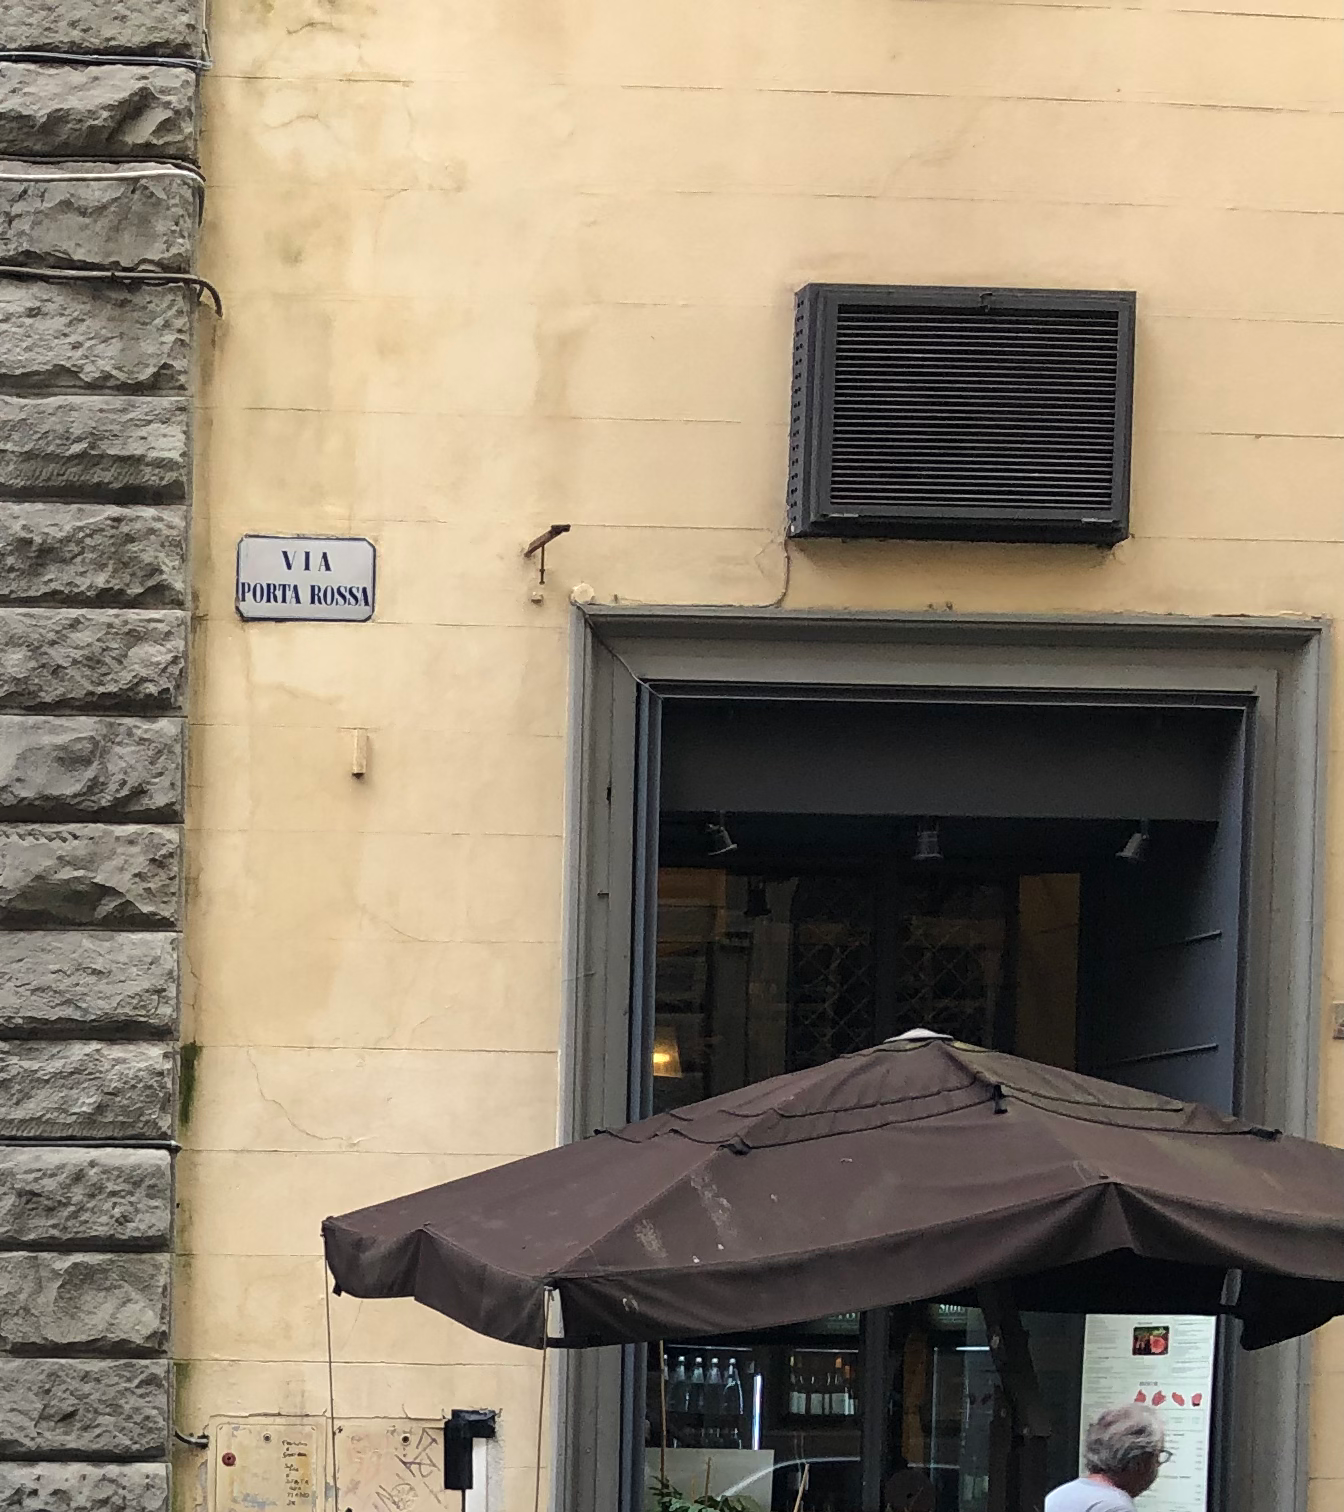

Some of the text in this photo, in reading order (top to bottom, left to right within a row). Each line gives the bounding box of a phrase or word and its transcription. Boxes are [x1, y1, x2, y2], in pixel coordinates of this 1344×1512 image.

[281, 550, 332, 572] VIA
[240, 582, 370, 607] PORTA ROSSA
